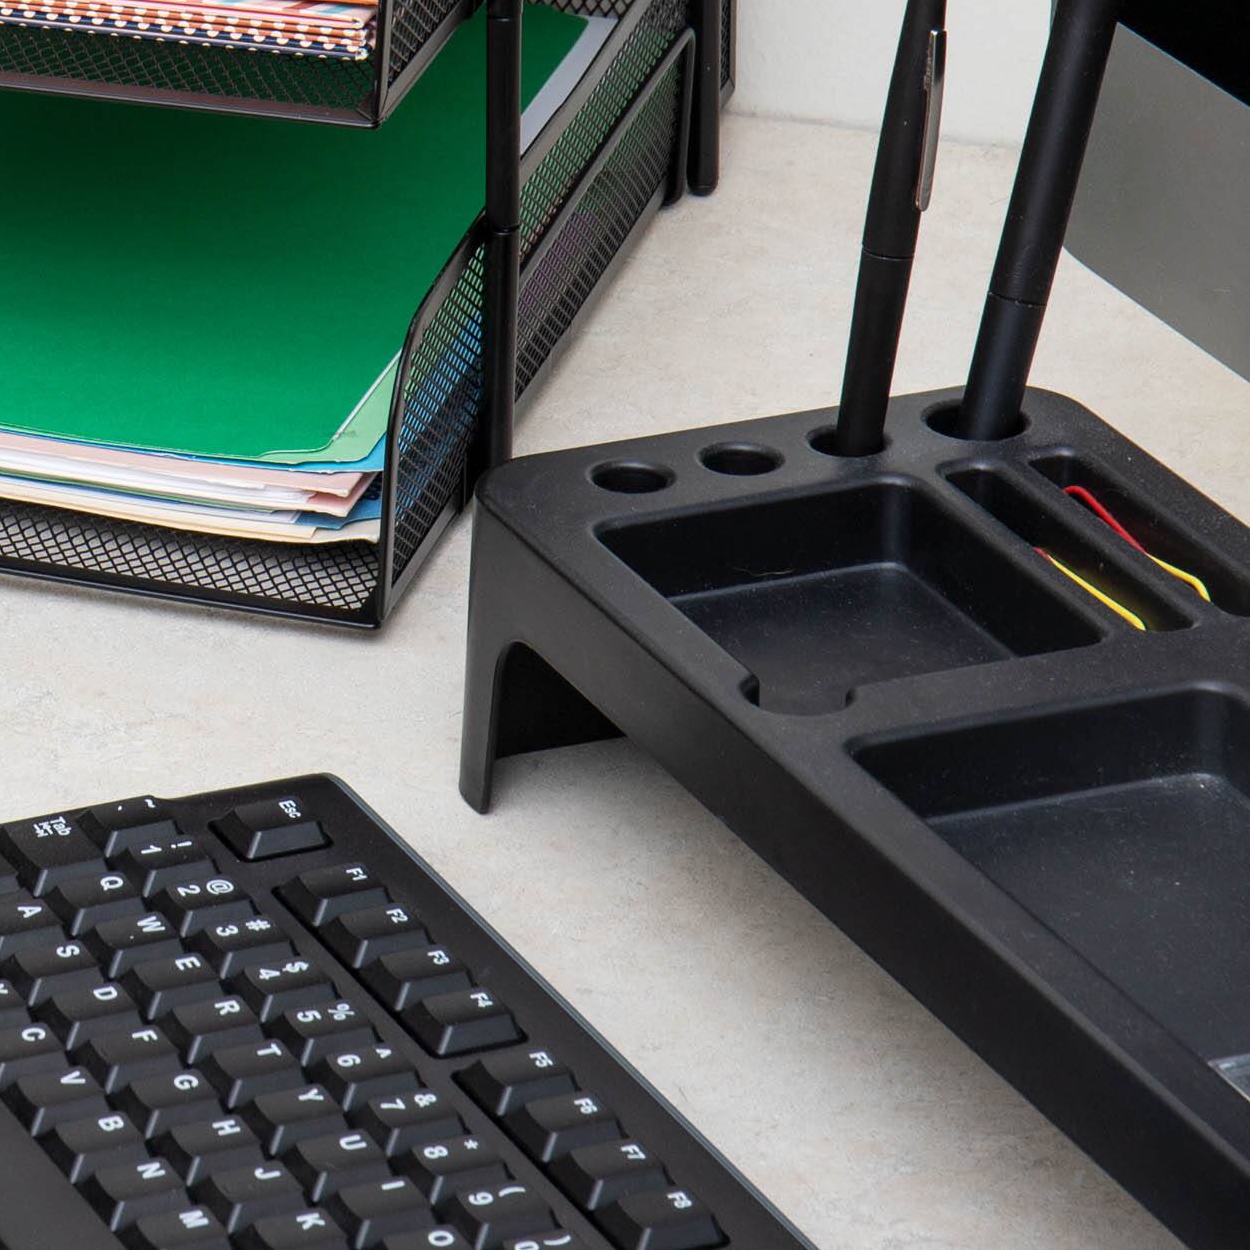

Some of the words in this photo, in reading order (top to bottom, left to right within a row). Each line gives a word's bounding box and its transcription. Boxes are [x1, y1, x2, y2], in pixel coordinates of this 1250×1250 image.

[278, 799, 302, 819] Esc
[49, 816, 72, 837] Tab
[140, 844, 163, 855] 1
[170, 840, 193, 849] !
[345, 867, 368, 881] F1
[99, 875, 124, 892] Q
[176, 884, 201, 897] 2
[205, 878, 235, 895] @
[16, 905, 43, 919] A
[385, 907, 409, 924] F2
[136, 915, 166, 933] W
[215, 924, 239, 937] 3
[245, 918, 271, 932] #
[55, 944, 81, 959] S
[427, 949, 450, 966] F3
[174, 955, 202, 971] E
[281, 960, 310, 974] $
[258, 967, 281, 981] 4
[92, 985, 119, 1001] D
[469, 991, 494, 1008] F4
[213, 999, 241, 1016] R
[327, 1002, 355, 1021] %
[296, 1009, 322, 1023] 5
[21, 1026, 47, 1042] C
[131, 1029, 159, 1042] F
[256, 1042, 283, 1056] T
[336, 1053, 362, 1068] 6
[528, 1051, 554, 1068] F5
[59, 1070, 87, 1085] V
[173, 1073, 199, 1091] G
[297, 1087, 325, 1102] Y
[413, 1093, 438, 1108] &
[379, 1097, 407, 1110] 7
[573, 1097, 598, 1115] F6
[97, 1114, 125, 1132] B
[211, 1118, 242, 1137] H
[338, 1134, 368, 1151] U
[423, 1144, 449, 1160] 8
[620, 1144, 647, 1160] F7
[136, 1161, 167, 1180] N
[253, 1167, 282, 1180] J
[467, 1191, 494, 1206] 9
[498, 1186, 526, 1198] (
[666, 1191, 693, 1209] F8
[178, 1209, 210, 1229] M
[295, 1212, 326, 1231] K
[427, 1229, 455, 1248] O
[543, 1234, 572, 1247] )
